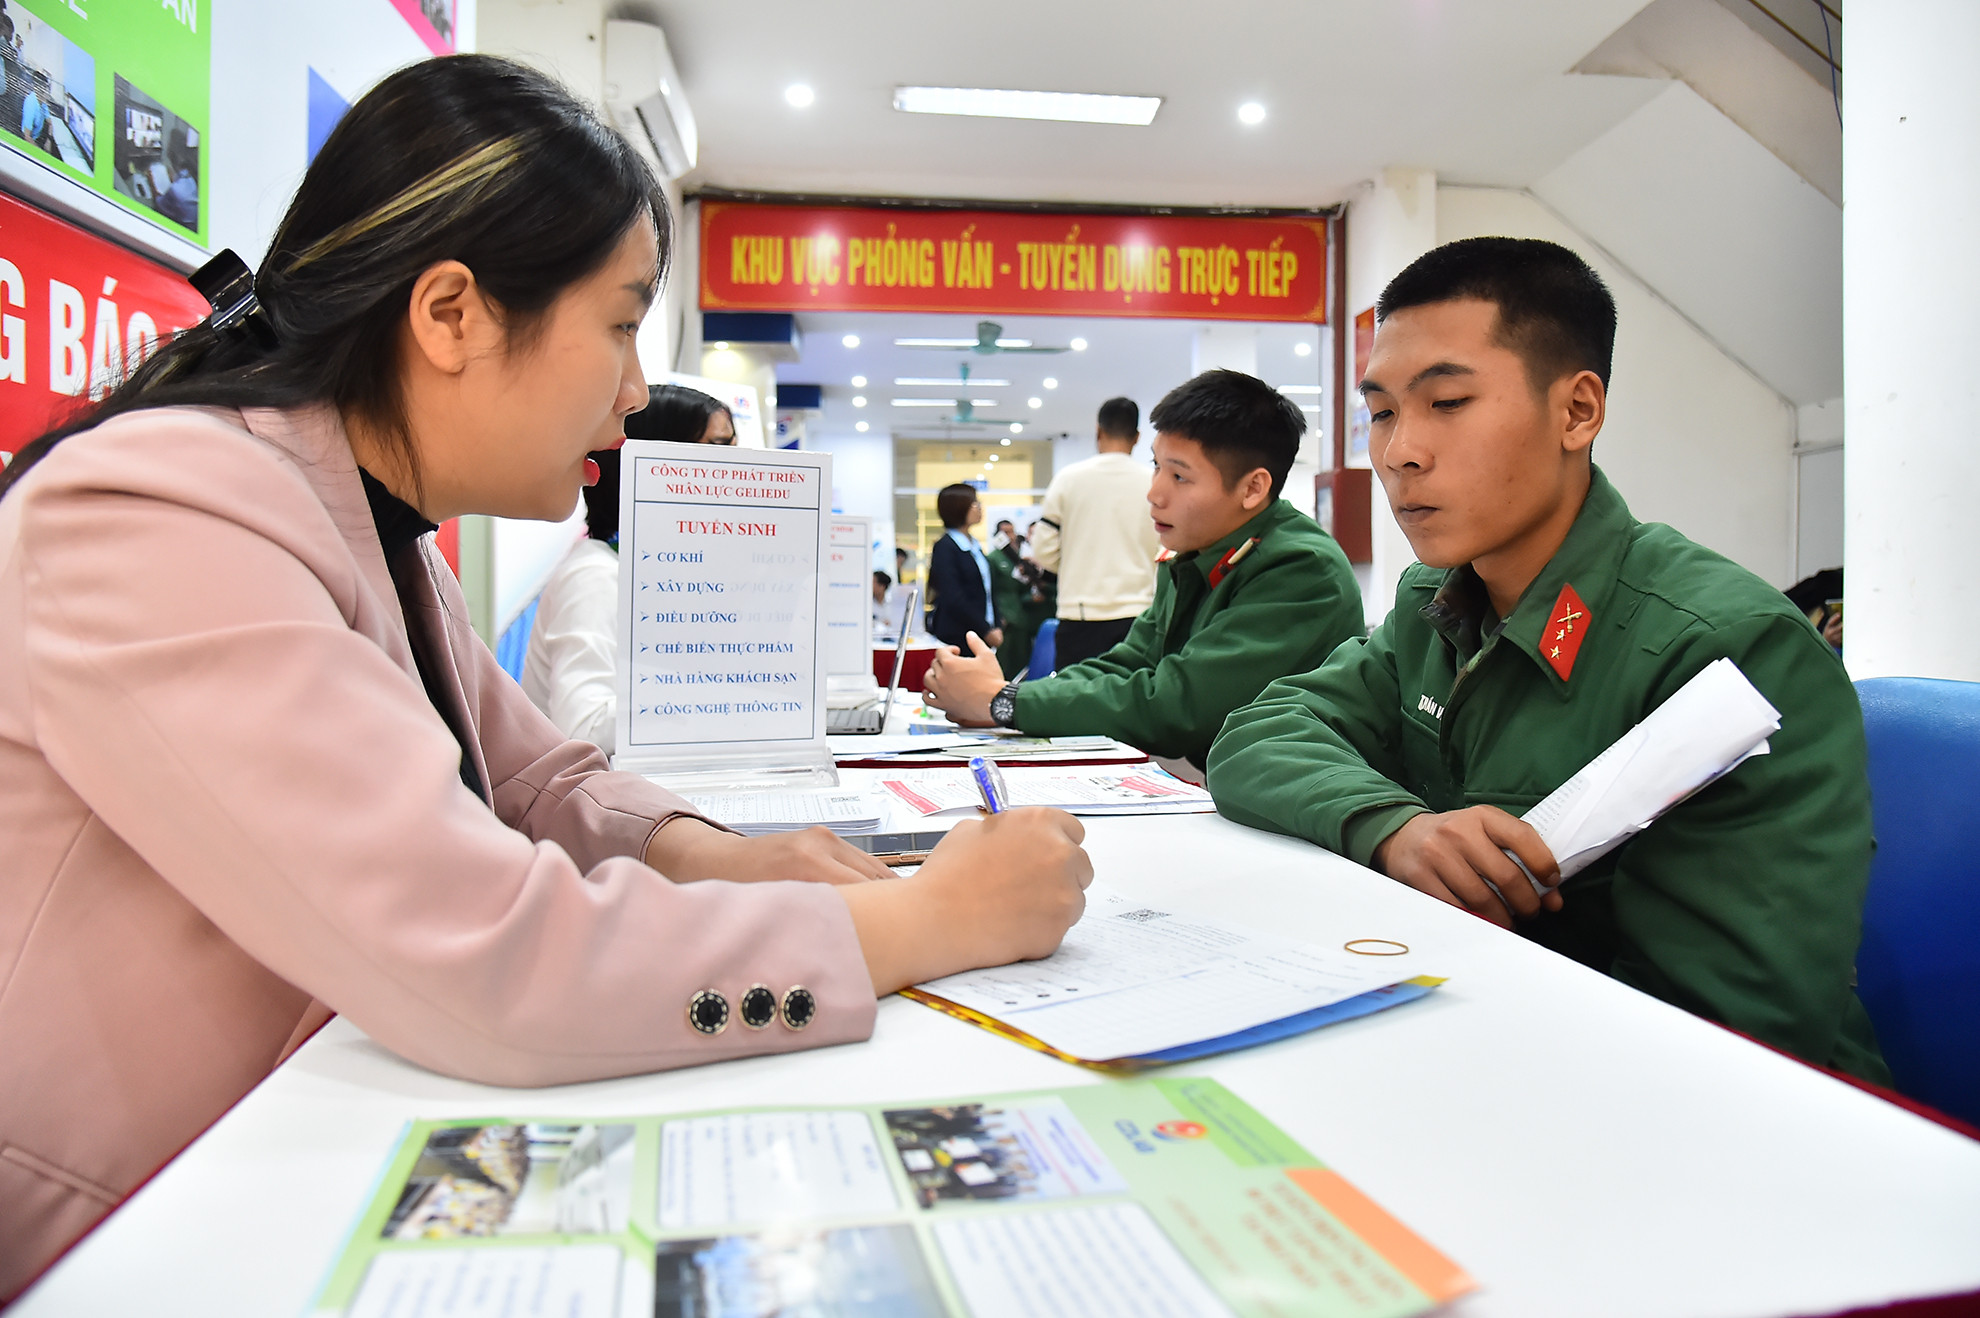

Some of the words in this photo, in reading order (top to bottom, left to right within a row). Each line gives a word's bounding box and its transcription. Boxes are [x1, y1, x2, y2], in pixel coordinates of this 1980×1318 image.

[731, 235, 784, 285] KHU
[848, 222, 935, 287] PHỎNG
[941, 223, 994, 289] VẤN
[1017, 223, 1096, 291] TUYỂN
[1103, 244, 1171, 303] DỤNG
[1177, 243, 1240, 306] TRỰC
[1246, 235, 1298, 297] TIẾP
[650, 463, 688, 478] CÔNG
[693, 468, 709, 479] TY
[712, 469, 728, 480] CP
[731, 468, 765, 482] PHÁT
[665, 481, 702, 495] NHÂN
[706, 485, 733, 499] LỰC
[735, 487, 791, 500] GELIEDU
[738, 522, 777, 537] SINH
[657, 552, 677, 563] CƠ
[680, 549, 704, 563] KHÍ
[656, 578, 684, 593] XÂY
[687, 581, 725, 595] DỰNG
[691, 610, 738, 624] DƯỠNG
[719, 642, 755, 655] THỰC
[655, 671, 683, 684] NHÀ
[686, 670, 723, 684] HÀNG
[726, 670, 771, 684] KHÁCH
[774, 672, 798, 684] SẠN
[654, 702, 692, 716] CÔNG
[695, 703, 731, 716] NGHỆ
[734, 699, 778, 713] THÔNG
[781, 701, 803, 712] TIN
